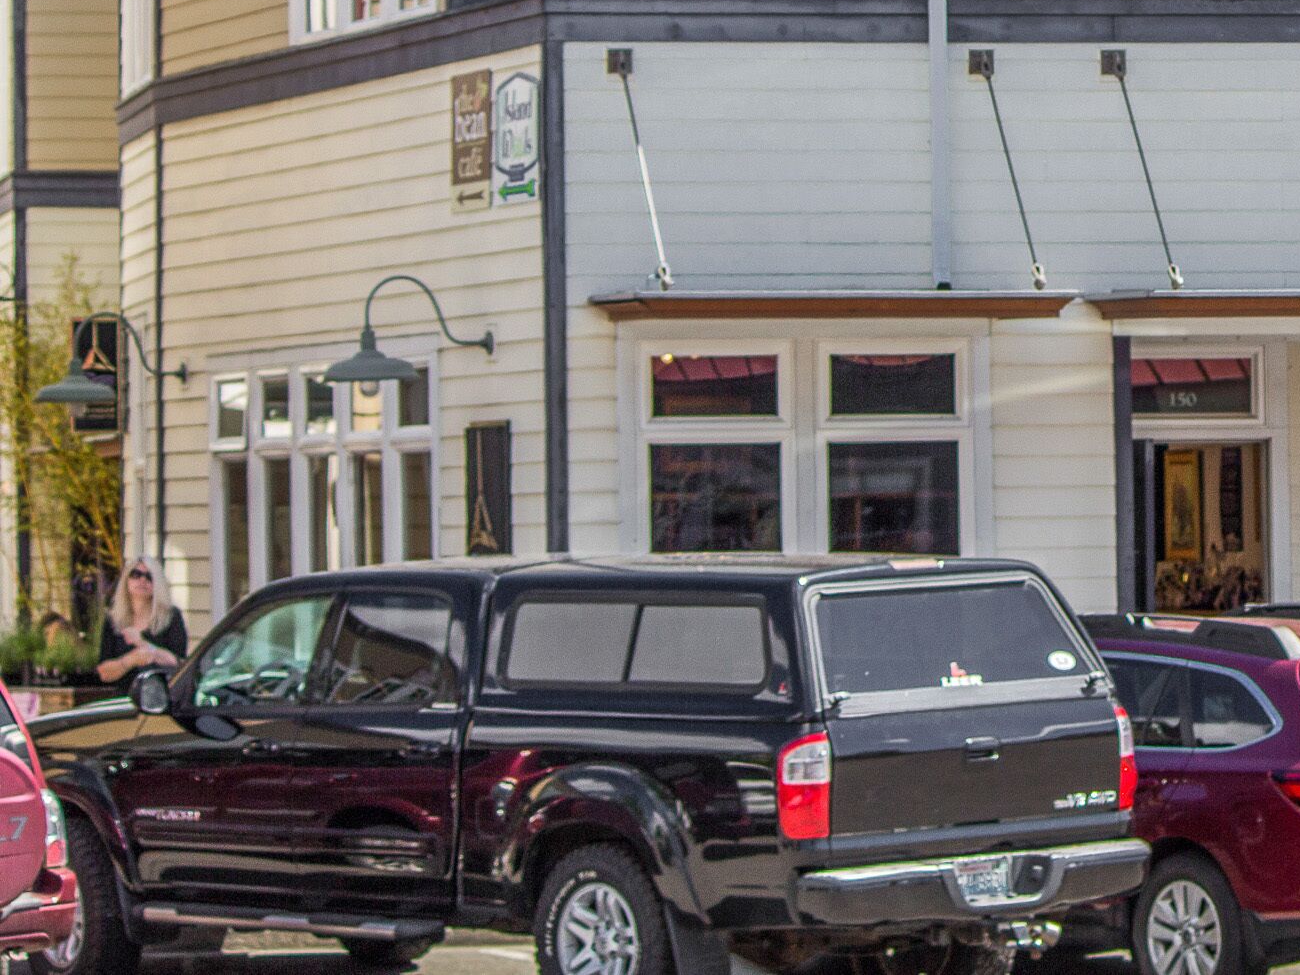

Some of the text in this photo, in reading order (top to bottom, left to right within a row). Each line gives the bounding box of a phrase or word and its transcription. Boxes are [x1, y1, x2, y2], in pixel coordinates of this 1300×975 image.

[504, 87, 533, 121] Island
[454, 96, 487, 144] bean
[1169, 390, 1198, 407] 150
[941, 675, 983, 688] LEER
